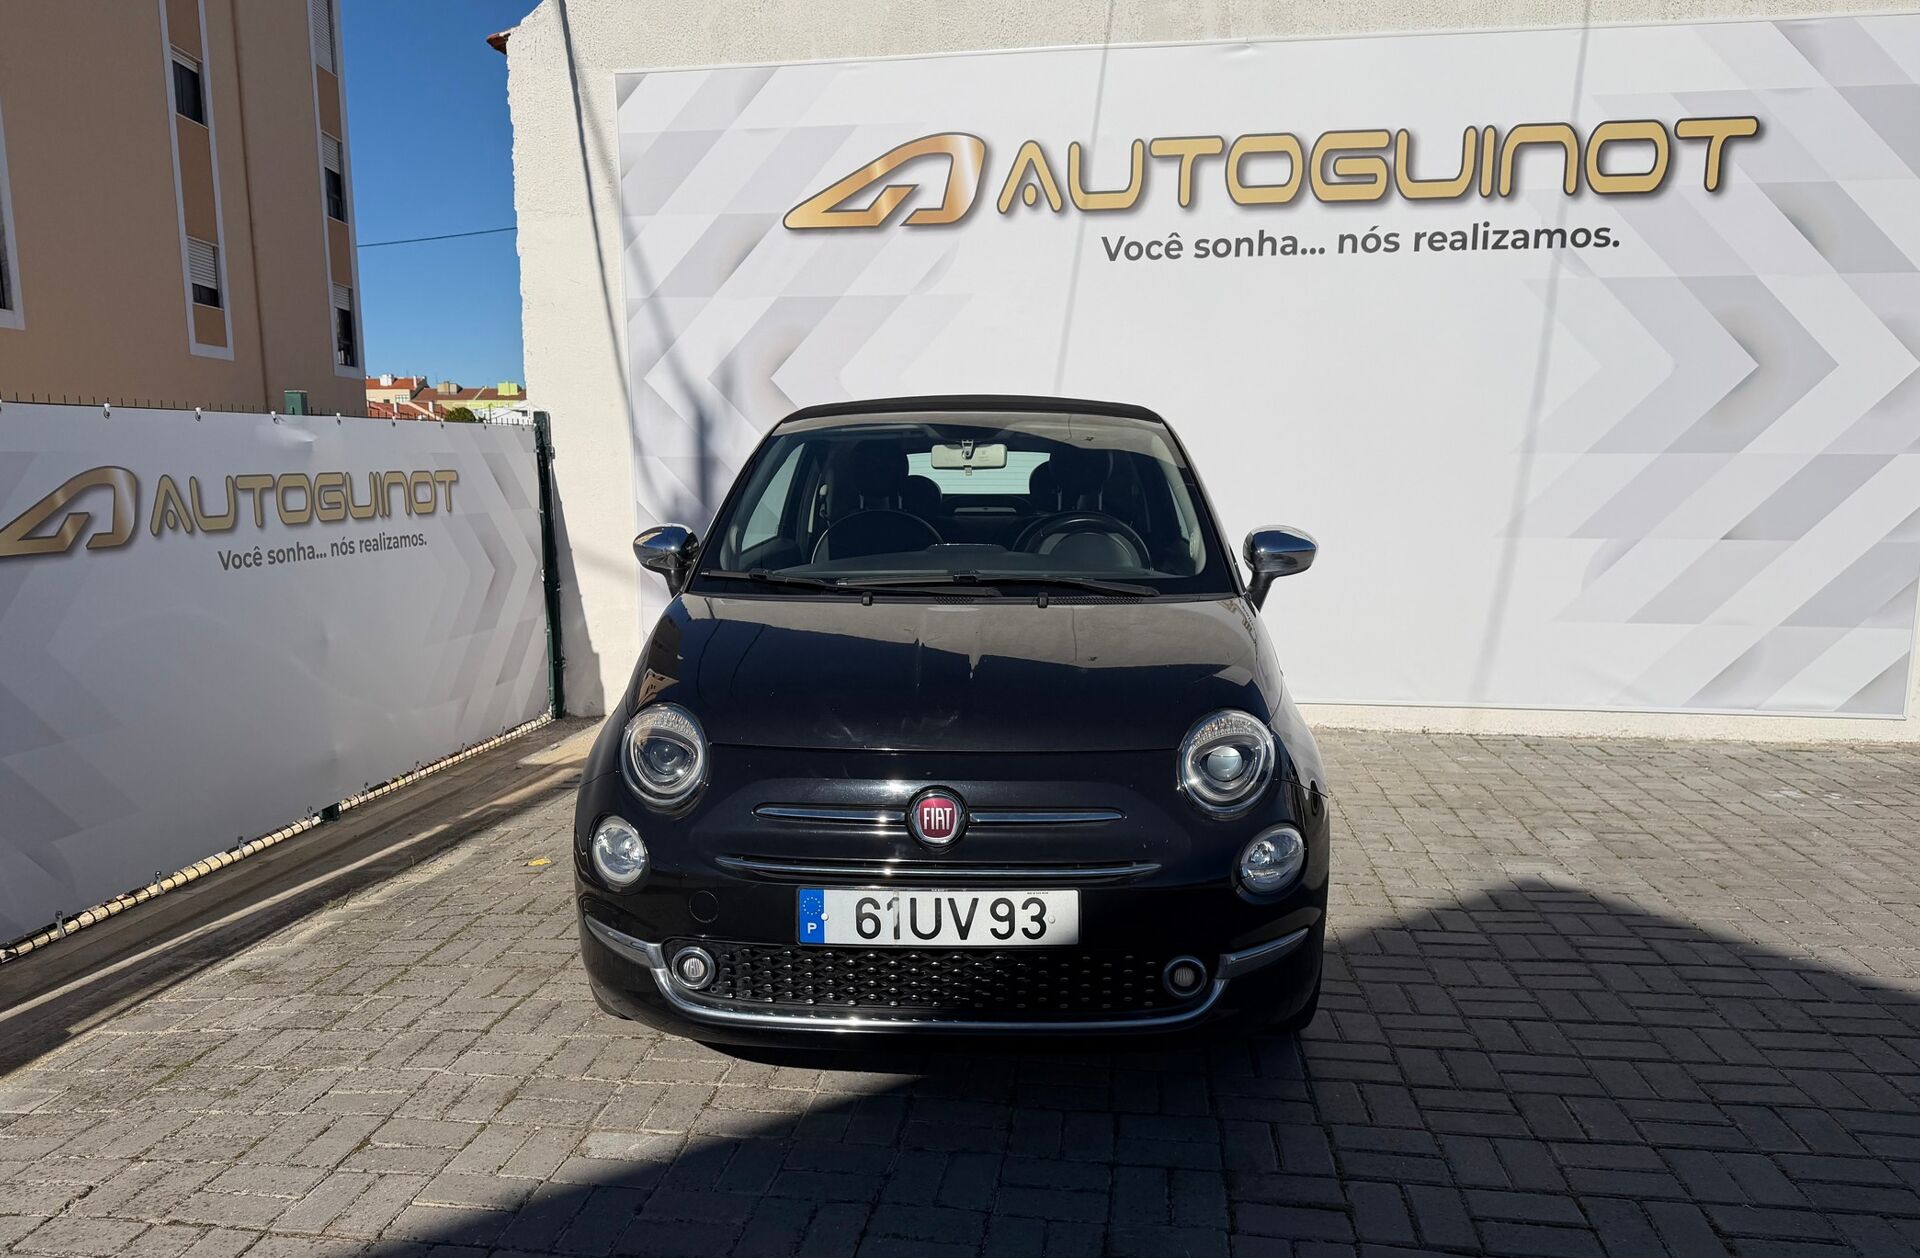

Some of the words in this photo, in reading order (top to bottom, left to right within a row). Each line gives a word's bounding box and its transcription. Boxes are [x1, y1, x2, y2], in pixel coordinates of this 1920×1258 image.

[997, 116, 1760, 215] AUTOGUINOT
[1101, 232, 1184, 262] Você
[1194, 229, 1326, 258] sonha...
[1337, 225, 1401, 254] nós
[1413, 221, 1621, 252] realizamos.
[150, 470, 458, 536] AUTOGUINOT
[218, 546, 263, 571] Você
[268, 540, 327, 565] sonha...
[331, 536, 356, 557] nós
[359, 532, 428, 556] realizamos.
[923, 807, 953, 830] FIAT
[807, 922, 817, 934] P
